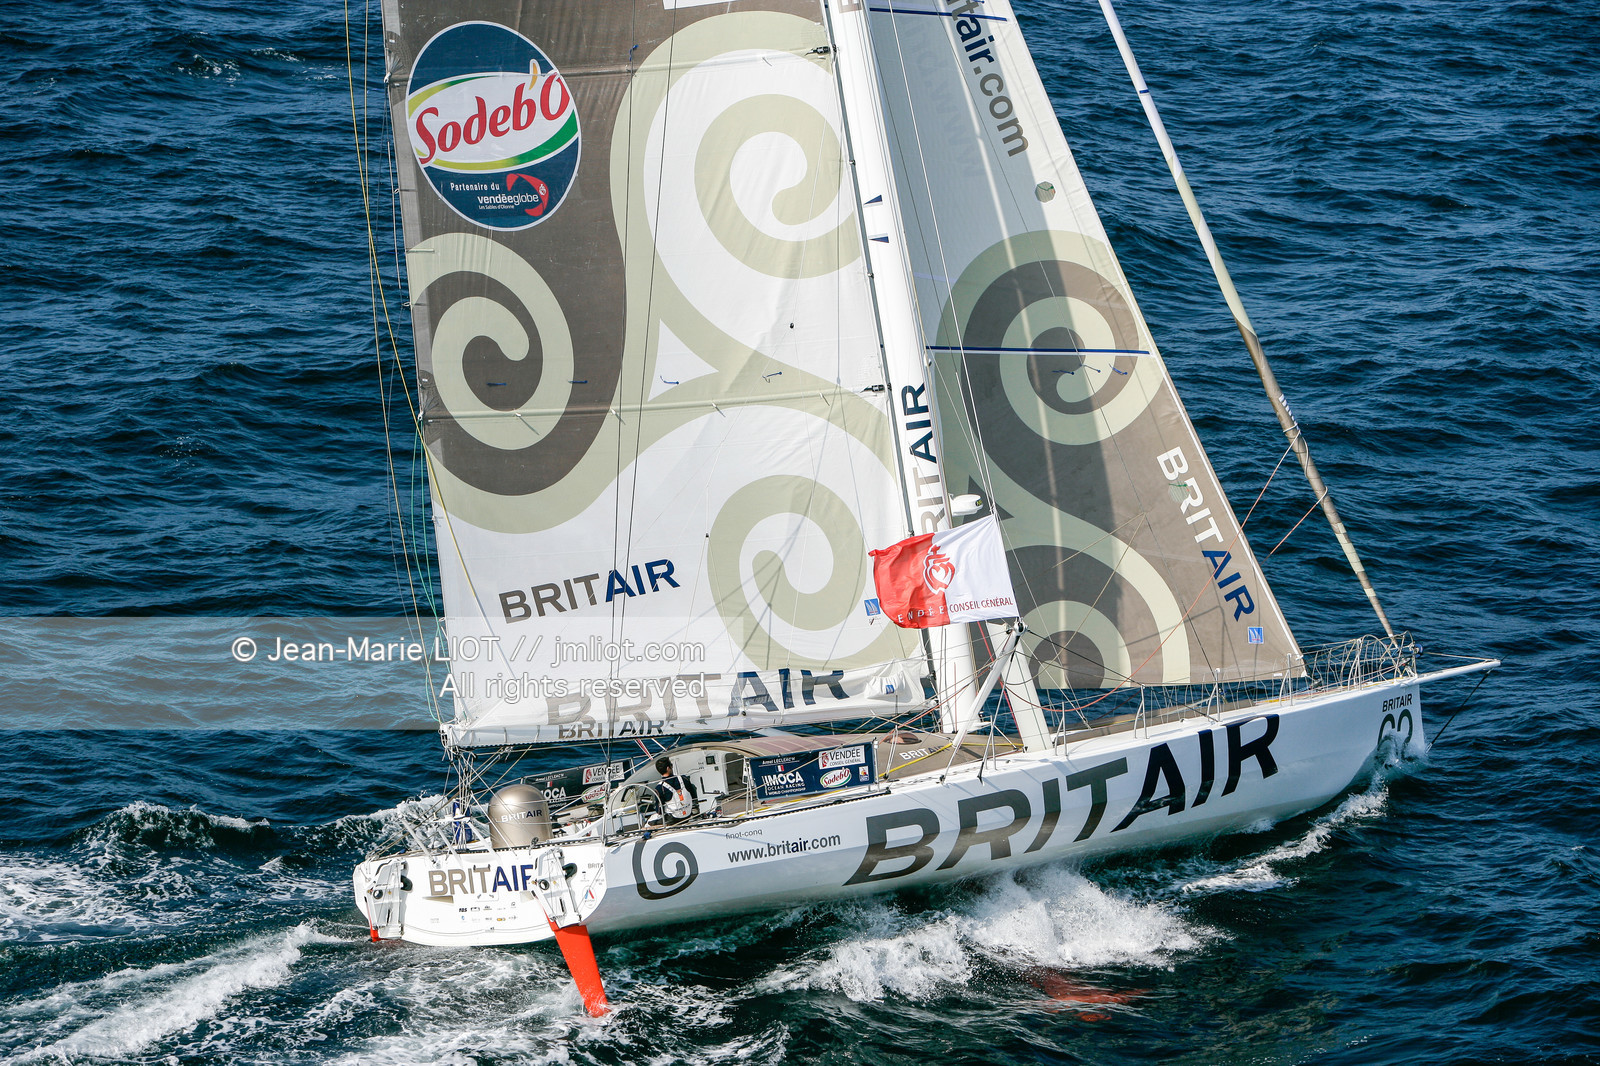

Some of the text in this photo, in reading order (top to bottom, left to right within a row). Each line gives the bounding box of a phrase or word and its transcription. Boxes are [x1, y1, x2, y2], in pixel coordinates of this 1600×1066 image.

[947, 0, 1029, 157] tair.com
[450, 181, 500, 191] Partenaire du
[901, 383, 946, 534] RITAIR
[1156, 446, 1255, 622] BRITAIR
[499, 558, 680, 624] BRITAIR
[897, 597, 1014, 623] ENDÉE CONSEIL GÉNÉRAL
[1382, 693, 1413, 712] BRITAIR
[830, 748, 861, 761] VENDÉE
[763, 771, 804, 787] IMOCA
[842, 713, 1280, 887] BRITAIR
[501, 809, 542, 822] BRITAIR
[728, 834, 841, 863] www.britair.com
